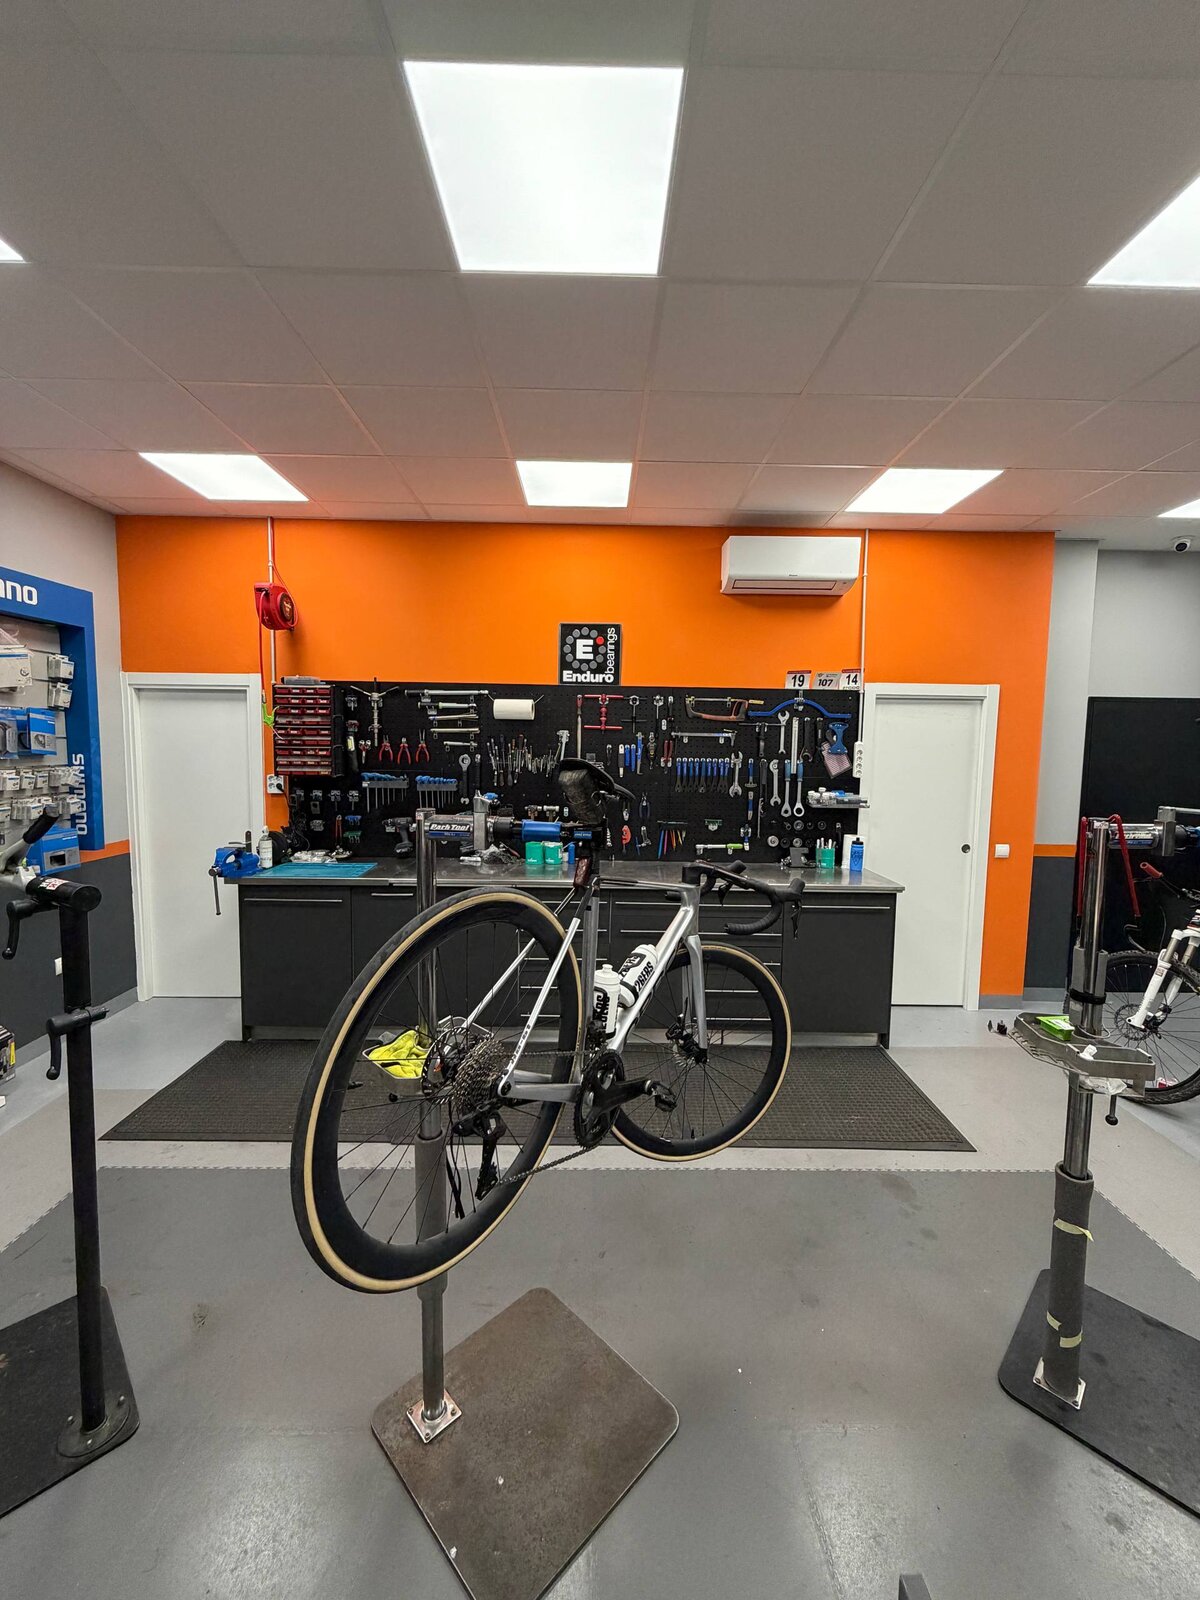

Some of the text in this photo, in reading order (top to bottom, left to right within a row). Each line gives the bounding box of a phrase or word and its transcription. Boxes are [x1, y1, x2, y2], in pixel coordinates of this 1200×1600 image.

[576, 639, 594, 660] E
[605, 627, 618, 674] bearings
[562, 670, 615, 683] Enduro
[791, 674, 805, 688] 19
[818, 679, 834, 687] 107
[846, 673, 858, 686] 14
